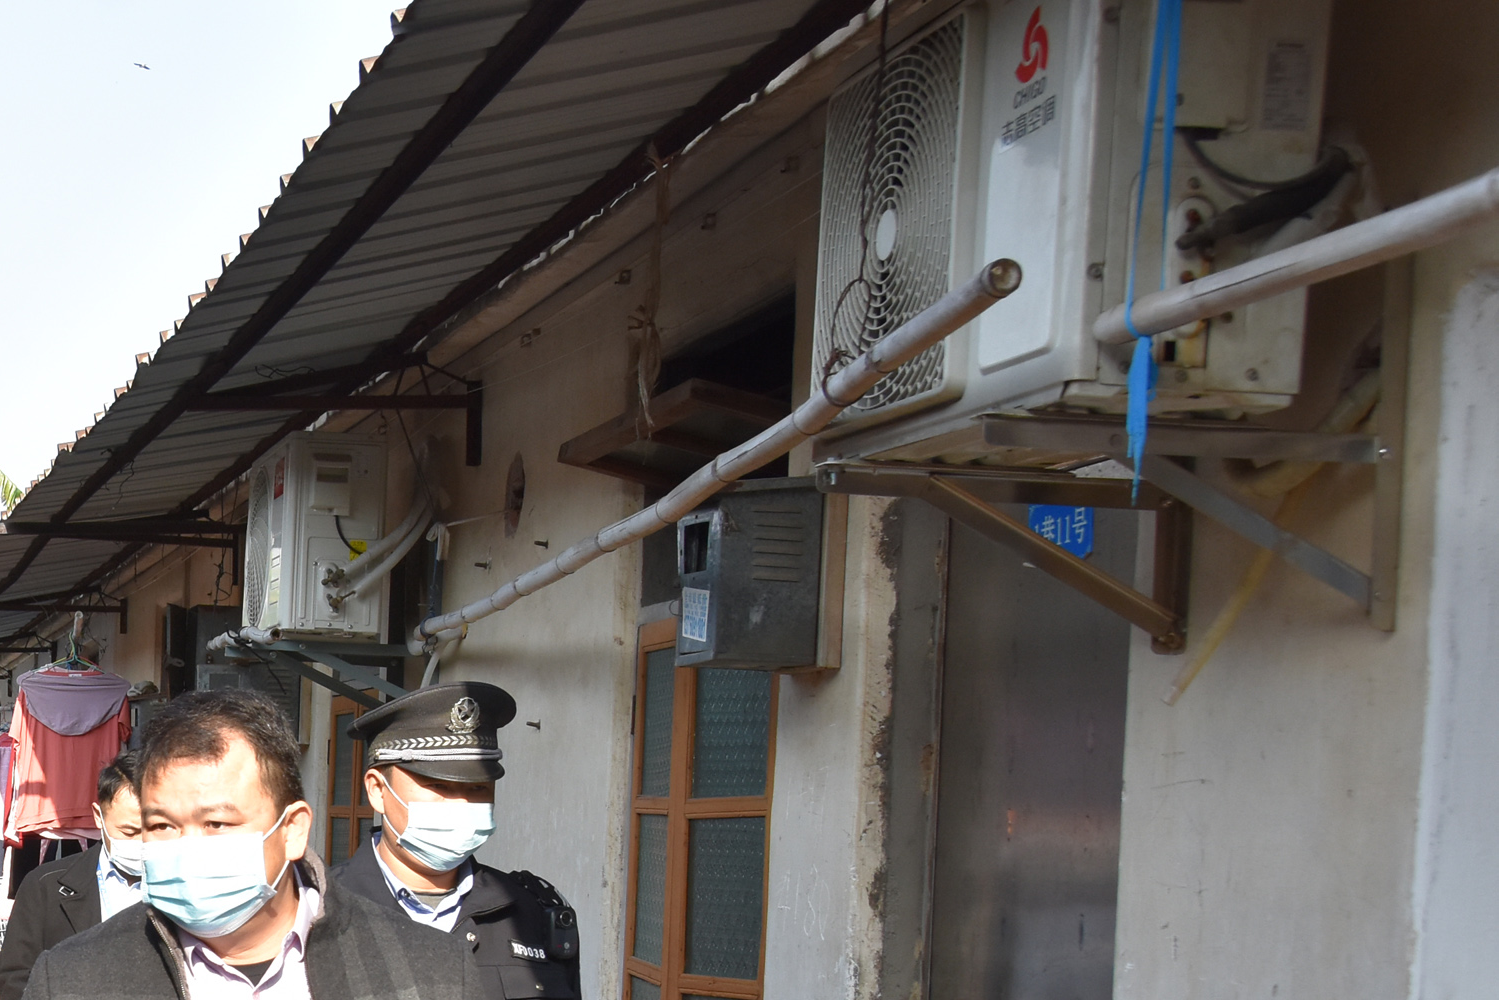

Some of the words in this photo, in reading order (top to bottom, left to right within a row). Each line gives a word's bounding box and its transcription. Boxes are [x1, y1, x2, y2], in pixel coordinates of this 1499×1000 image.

[1013, 76, 1047, 109] CHIGO
[1001, 94, 1055, 146] 志高空调
